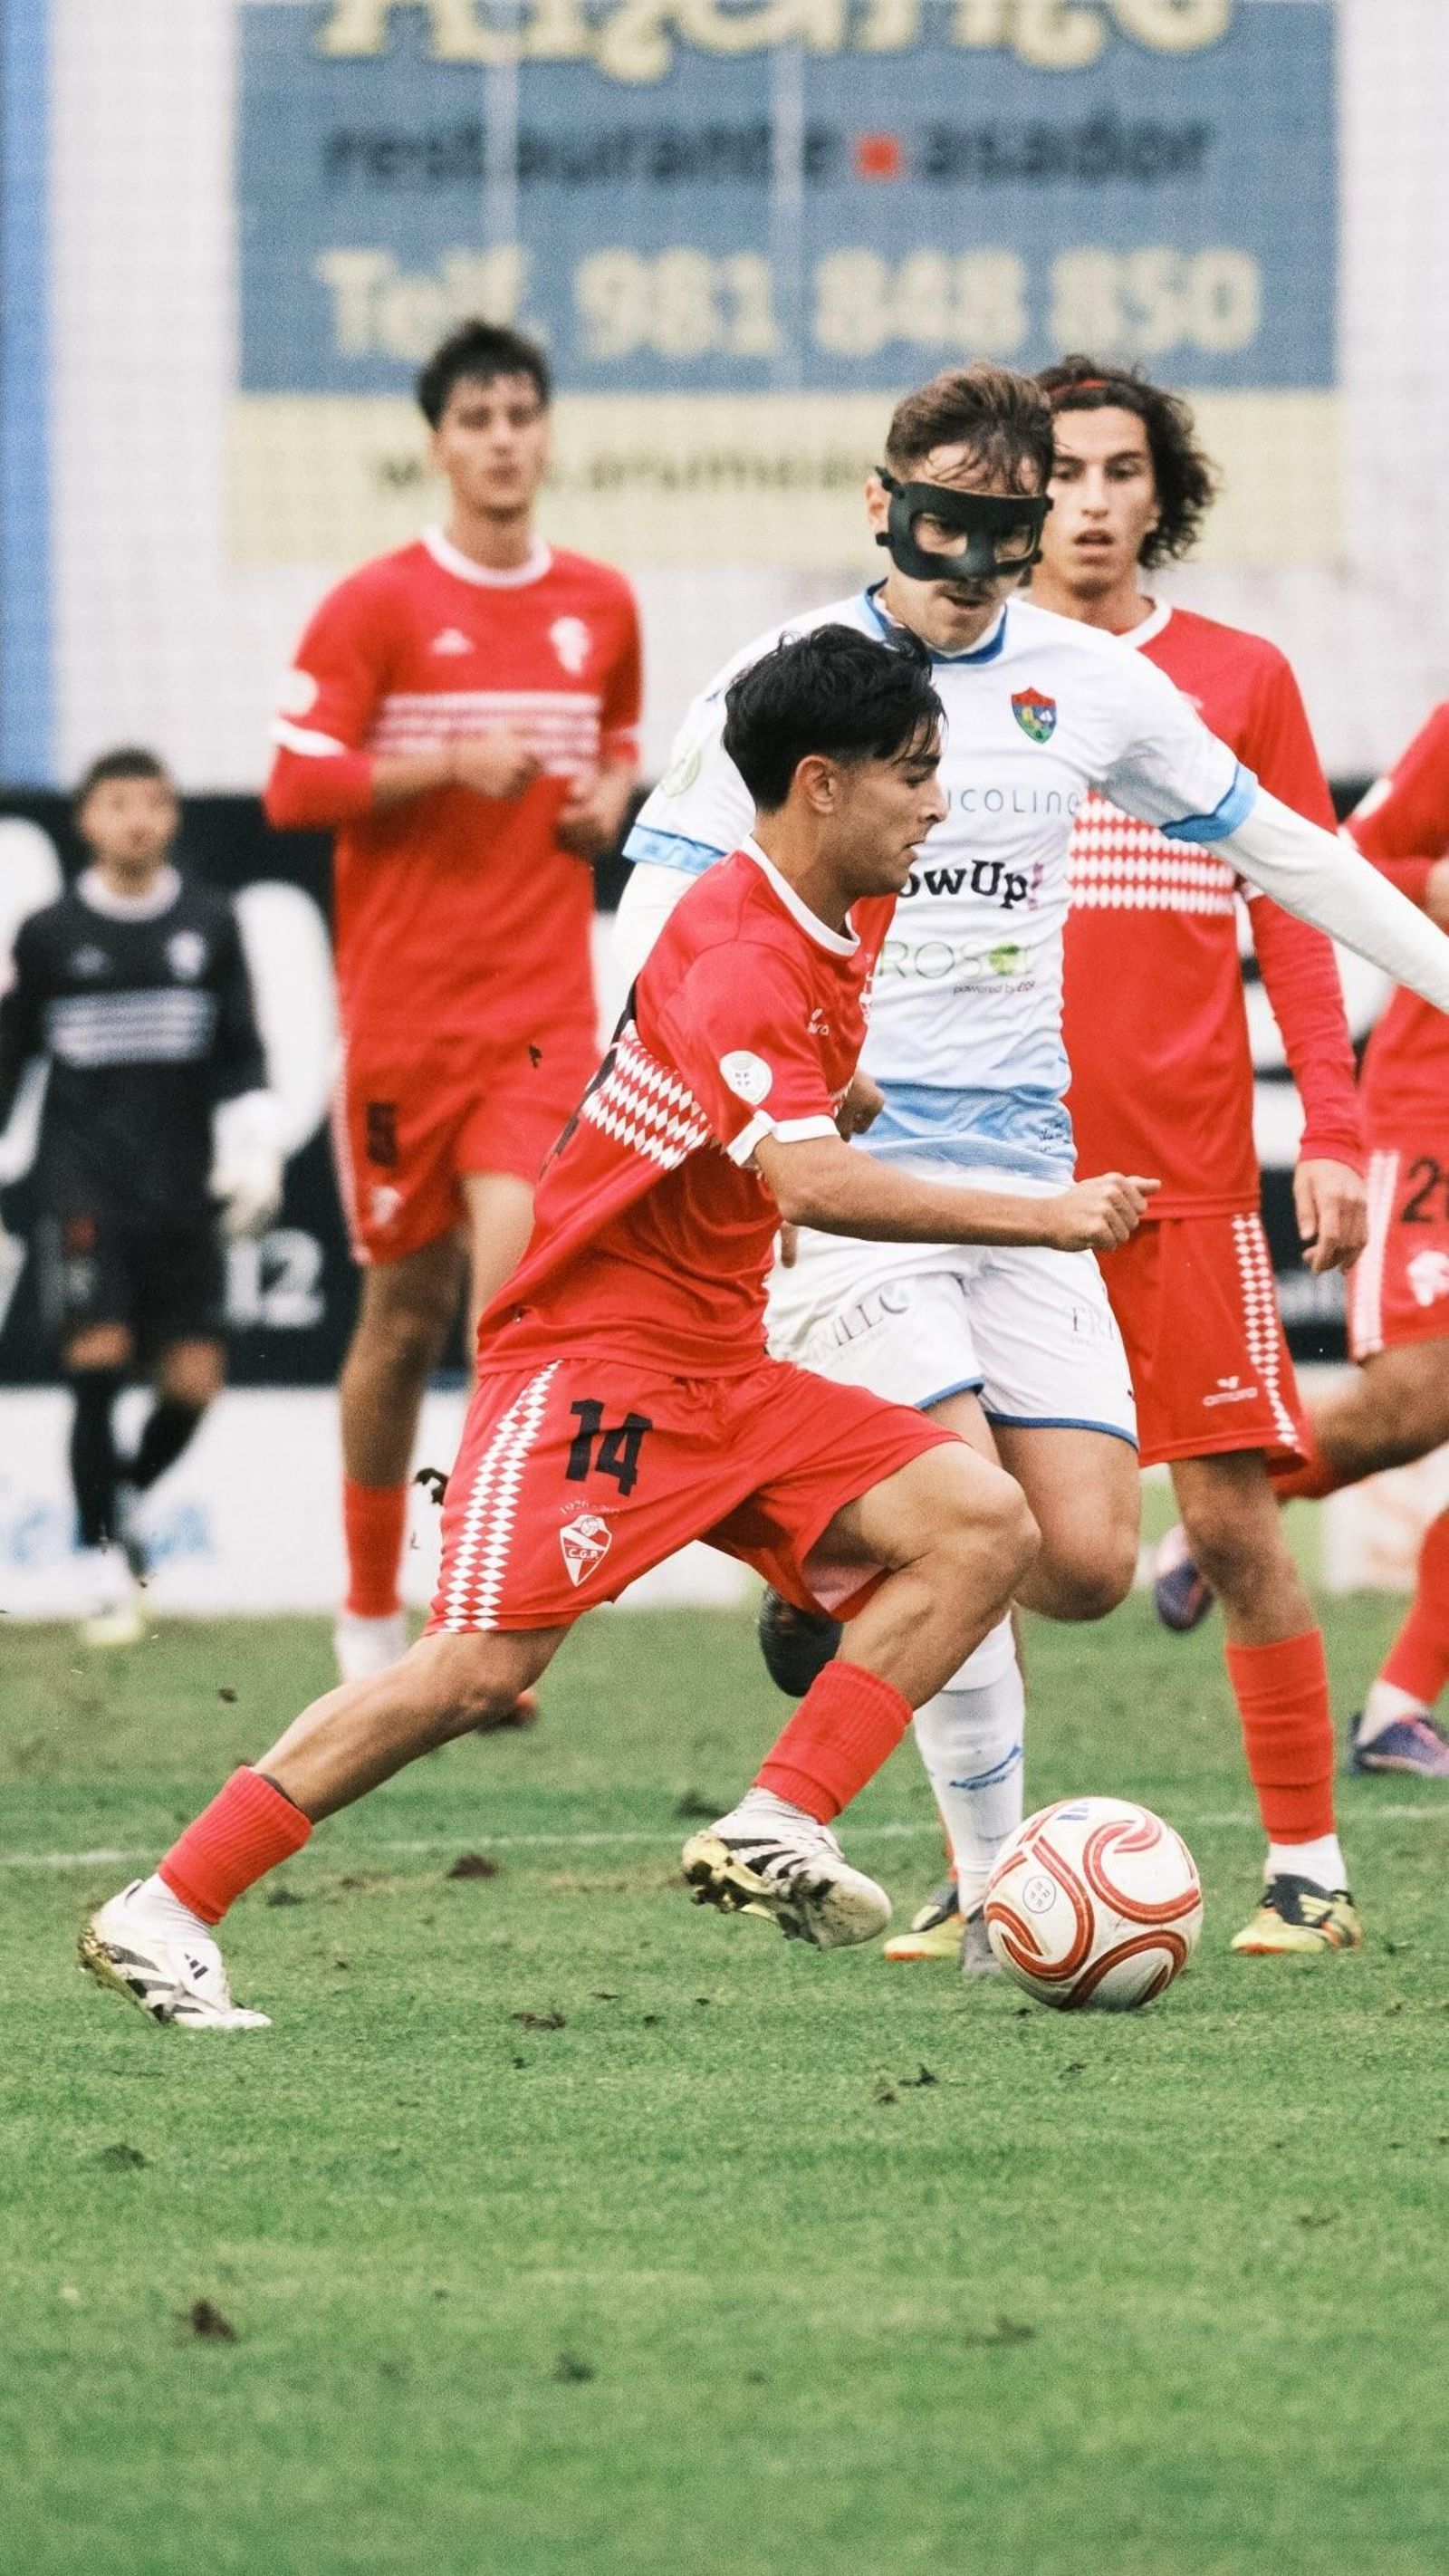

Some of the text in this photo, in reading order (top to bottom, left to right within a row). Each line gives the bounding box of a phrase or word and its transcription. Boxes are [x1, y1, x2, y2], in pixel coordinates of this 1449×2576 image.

[576, 246, 781, 359] 981
[817, 246, 1025, 357] 848
[1401, 1155, 1449, 1223] 2
[565, 1398, 652, 1497] 14
